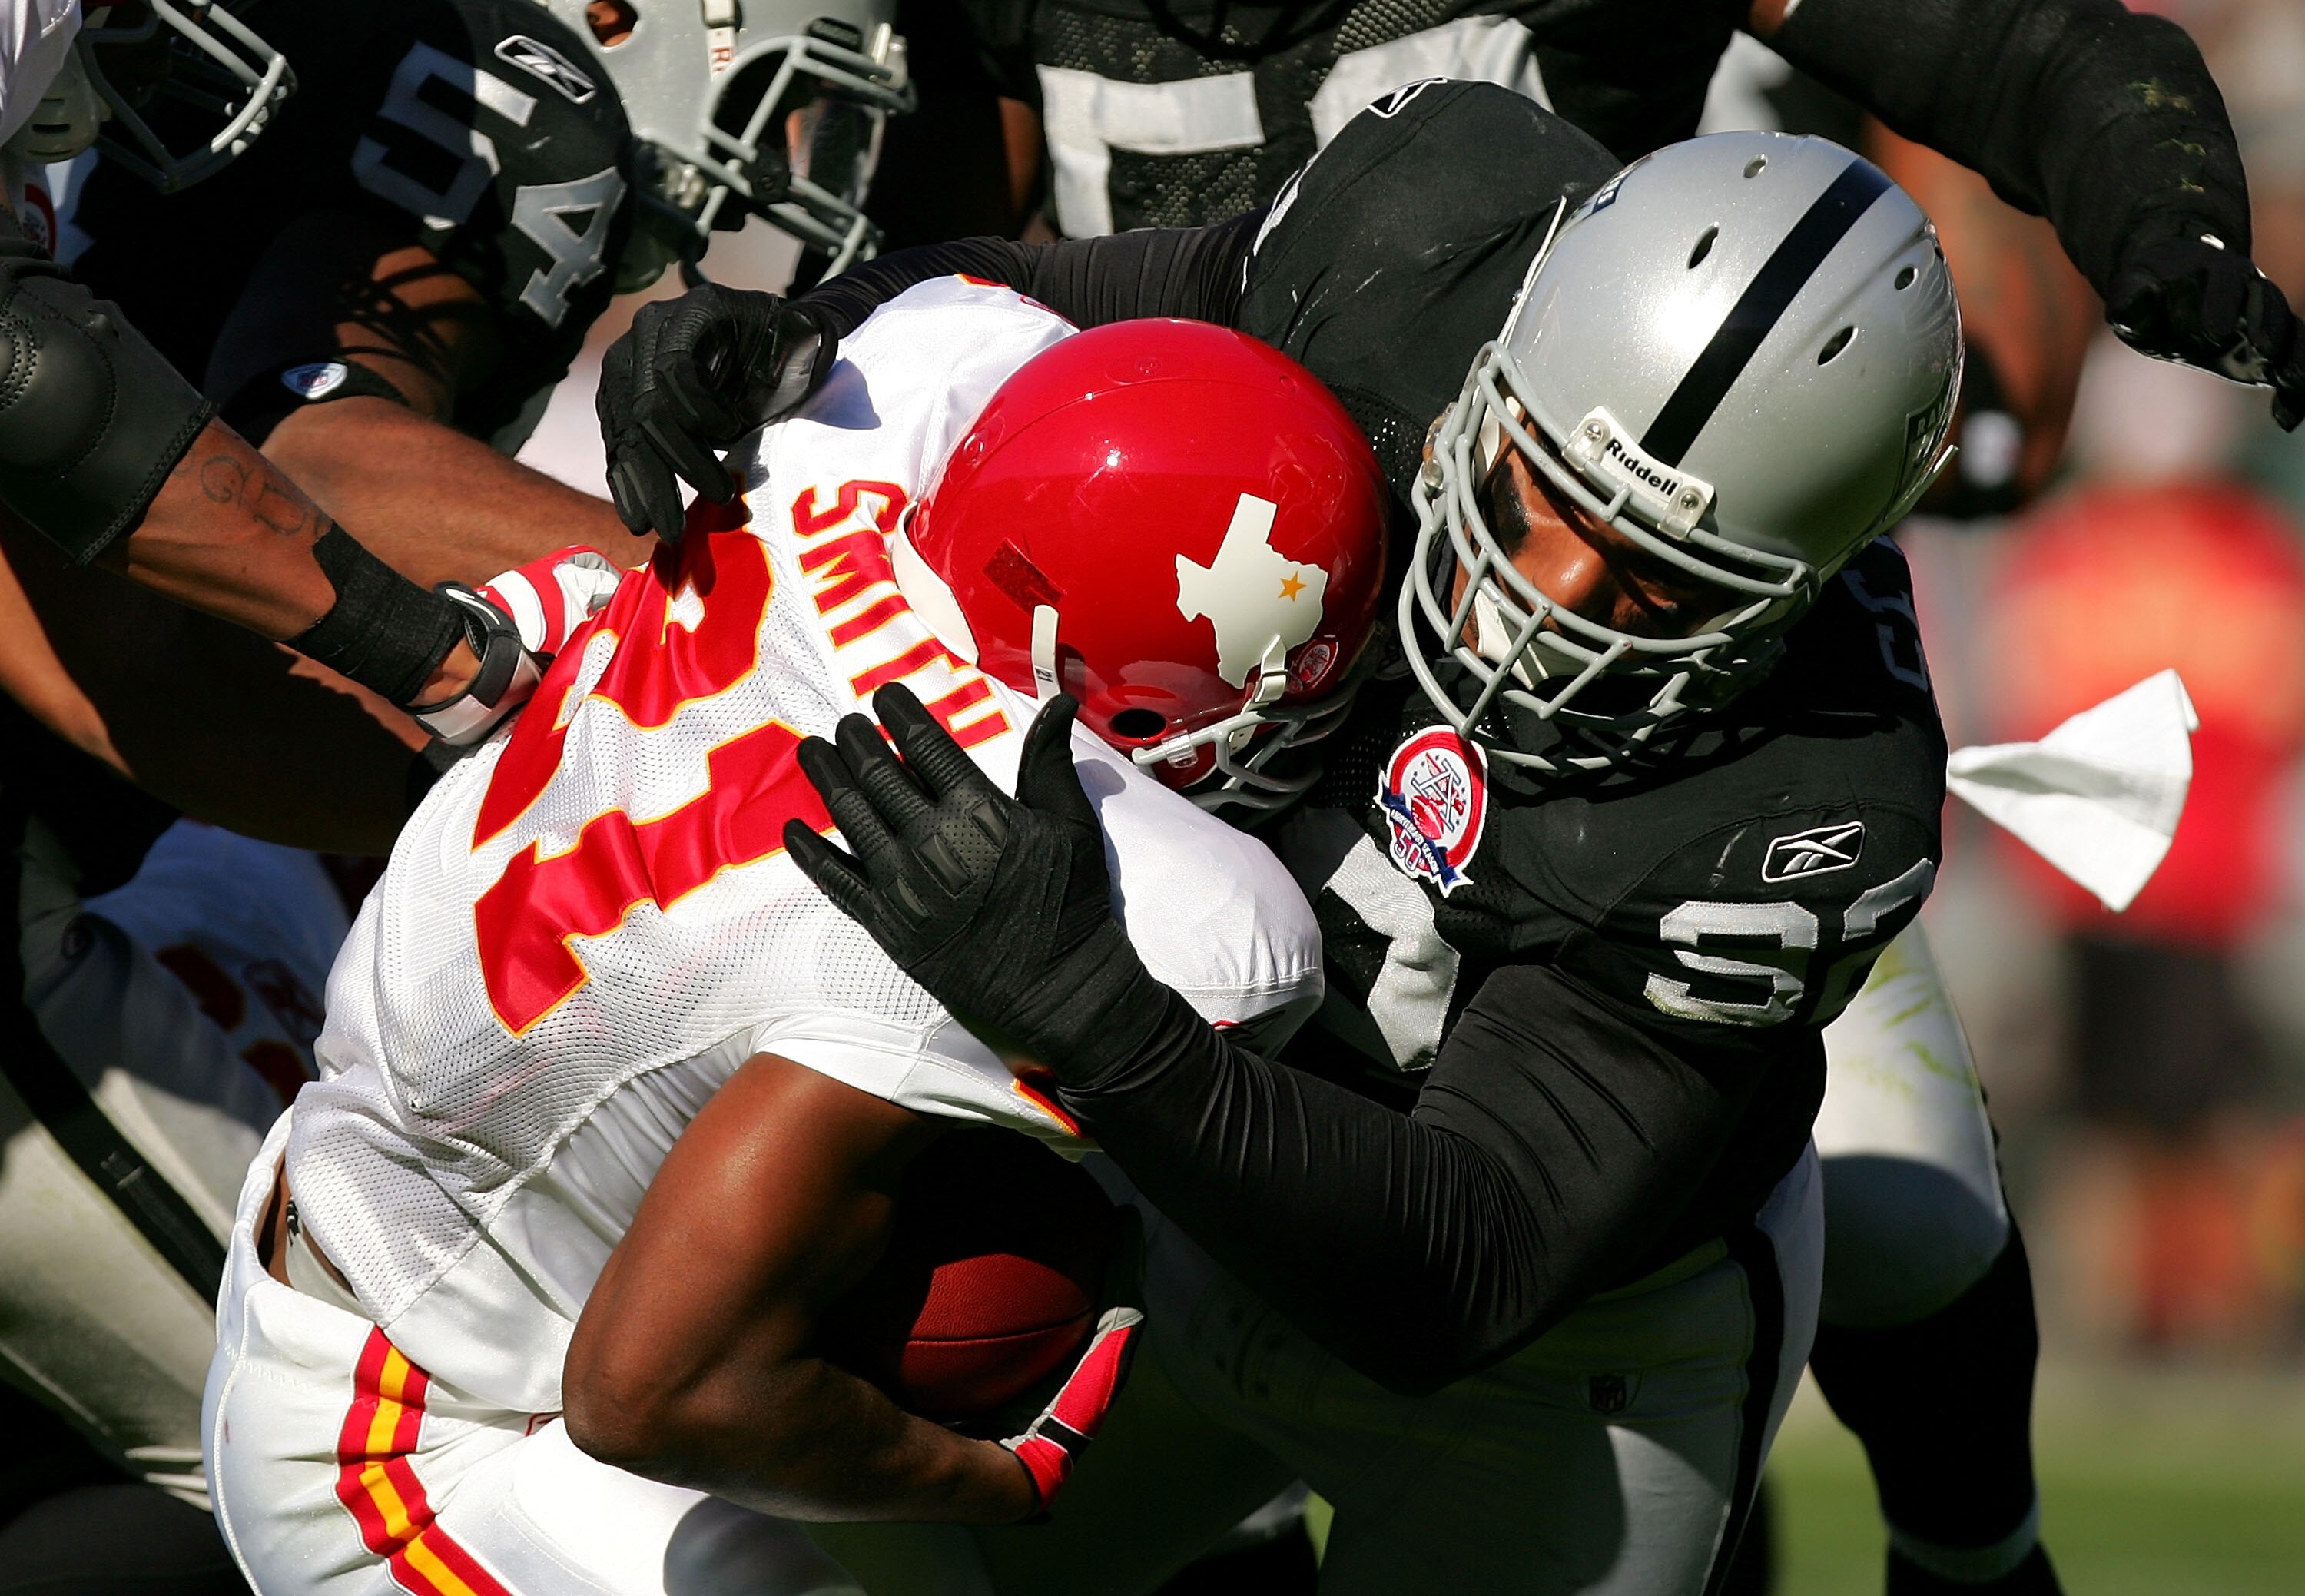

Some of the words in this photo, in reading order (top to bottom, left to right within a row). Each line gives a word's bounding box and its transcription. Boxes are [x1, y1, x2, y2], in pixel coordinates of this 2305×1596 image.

[350, 39, 628, 330] 54
[1606, 437, 1678, 496] Riddell
[470, 470, 841, 1040] 21
[1034, 667, 1055, 683] 21
[1643, 858, 1936, 1028] 92
